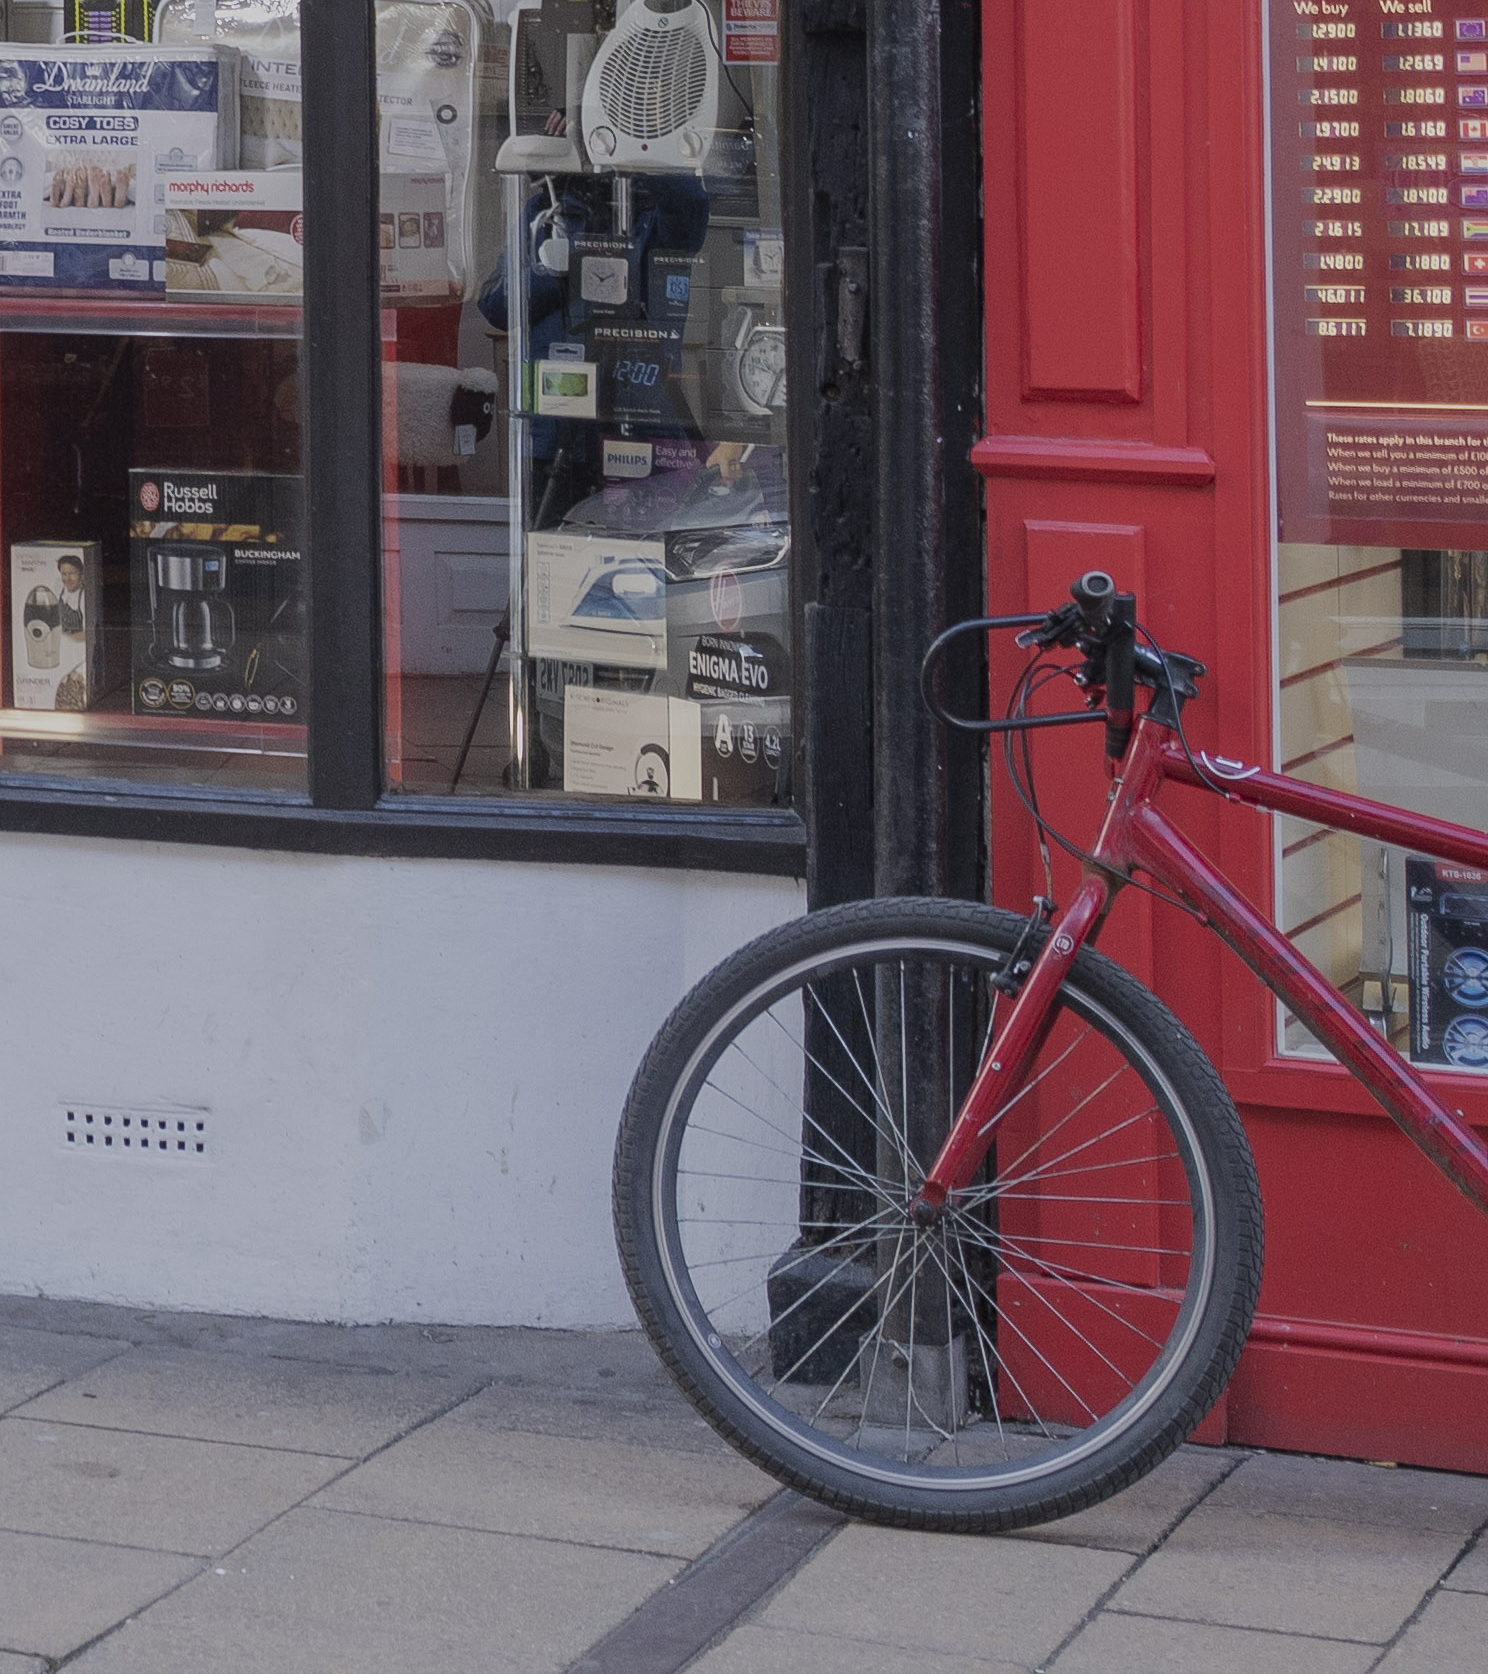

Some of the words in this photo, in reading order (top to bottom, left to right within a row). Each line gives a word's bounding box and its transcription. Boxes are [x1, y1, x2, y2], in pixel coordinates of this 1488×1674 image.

[1294, 1, 1319, 14] We
[1322, 0, 1348, 17] buy
[1379, 0, 1405, 13] We
[33, 61, 154, 92] Dreamland
[67, 95, 116, 105] STARLIGHT
[49, 117, 92, 129] COSY
[97, 118, 135, 130] TOES
[92, 136, 138, 145] LARGE
[169, 180, 209, 195] morphy
[210, 180, 254, 193] richards
[575, 241, 626, 249] PRECISION
[595, 328, 667, 339] PRECISION
[1327, 433, 1353, 443] These
[1355, 435, 1376, 443] rates
[1379, 435, 1403, 446] apply
[1406, 435, 1414, 444] in
[1417, 435, 1432, 445] this
[1434, 436, 1465, 446] branch
[1468, 436, 1481, 446] for
[656, 445, 677, 457] Easy
[679, 449, 696, 458] and
[1327, 448, 1355, 458] When
[1373, 449, 1388, 458] sell
[1390, 452, 1406, 460] you
[1416, 452, 1456, 460] minimum
[1459, 451, 1468, 460] of
[608, 454, 647, 466] PHILIPS
[1327, 462, 1355, 472] When
[1373, 464, 1389, 475] buy
[1400, 465, 1439, 474] minimum
[1442, 465, 1451, 474] of
[1454, 466, 1476, 475] £500
[1327, 477, 1356, 486] When
[1373, 478, 1393, 487] load
[1402, 480, 1443, 488] minimum
[1445, 480, 1454, 489] of
[1457, 481, 1480, 489] £700
[164, 482, 217, 500] Russell
[1328, 491, 1352, 500] Rates
[1354, 491, 1367, 500] for
[1369, 492, 1393, 501] other
[1396, 494, 1441, 503] currencies
[1443, 495, 1460, 503] and
[1462, 496, 1488, 504] smalle
[165, 498, 213, 513] Hobbs
[235, 550, 300, 560] BUCKINGHAM
[689, 651, 739, 684] ENIGMA
[742, 662, 768, 690] EVO
[1420, 914, 1429, 948] Outdoor
[1420, 949, 1429, 985] Portable
[1421, 986, 1430, 1023] Wireless
[1422, 1024, 1430, 1049] Audio
